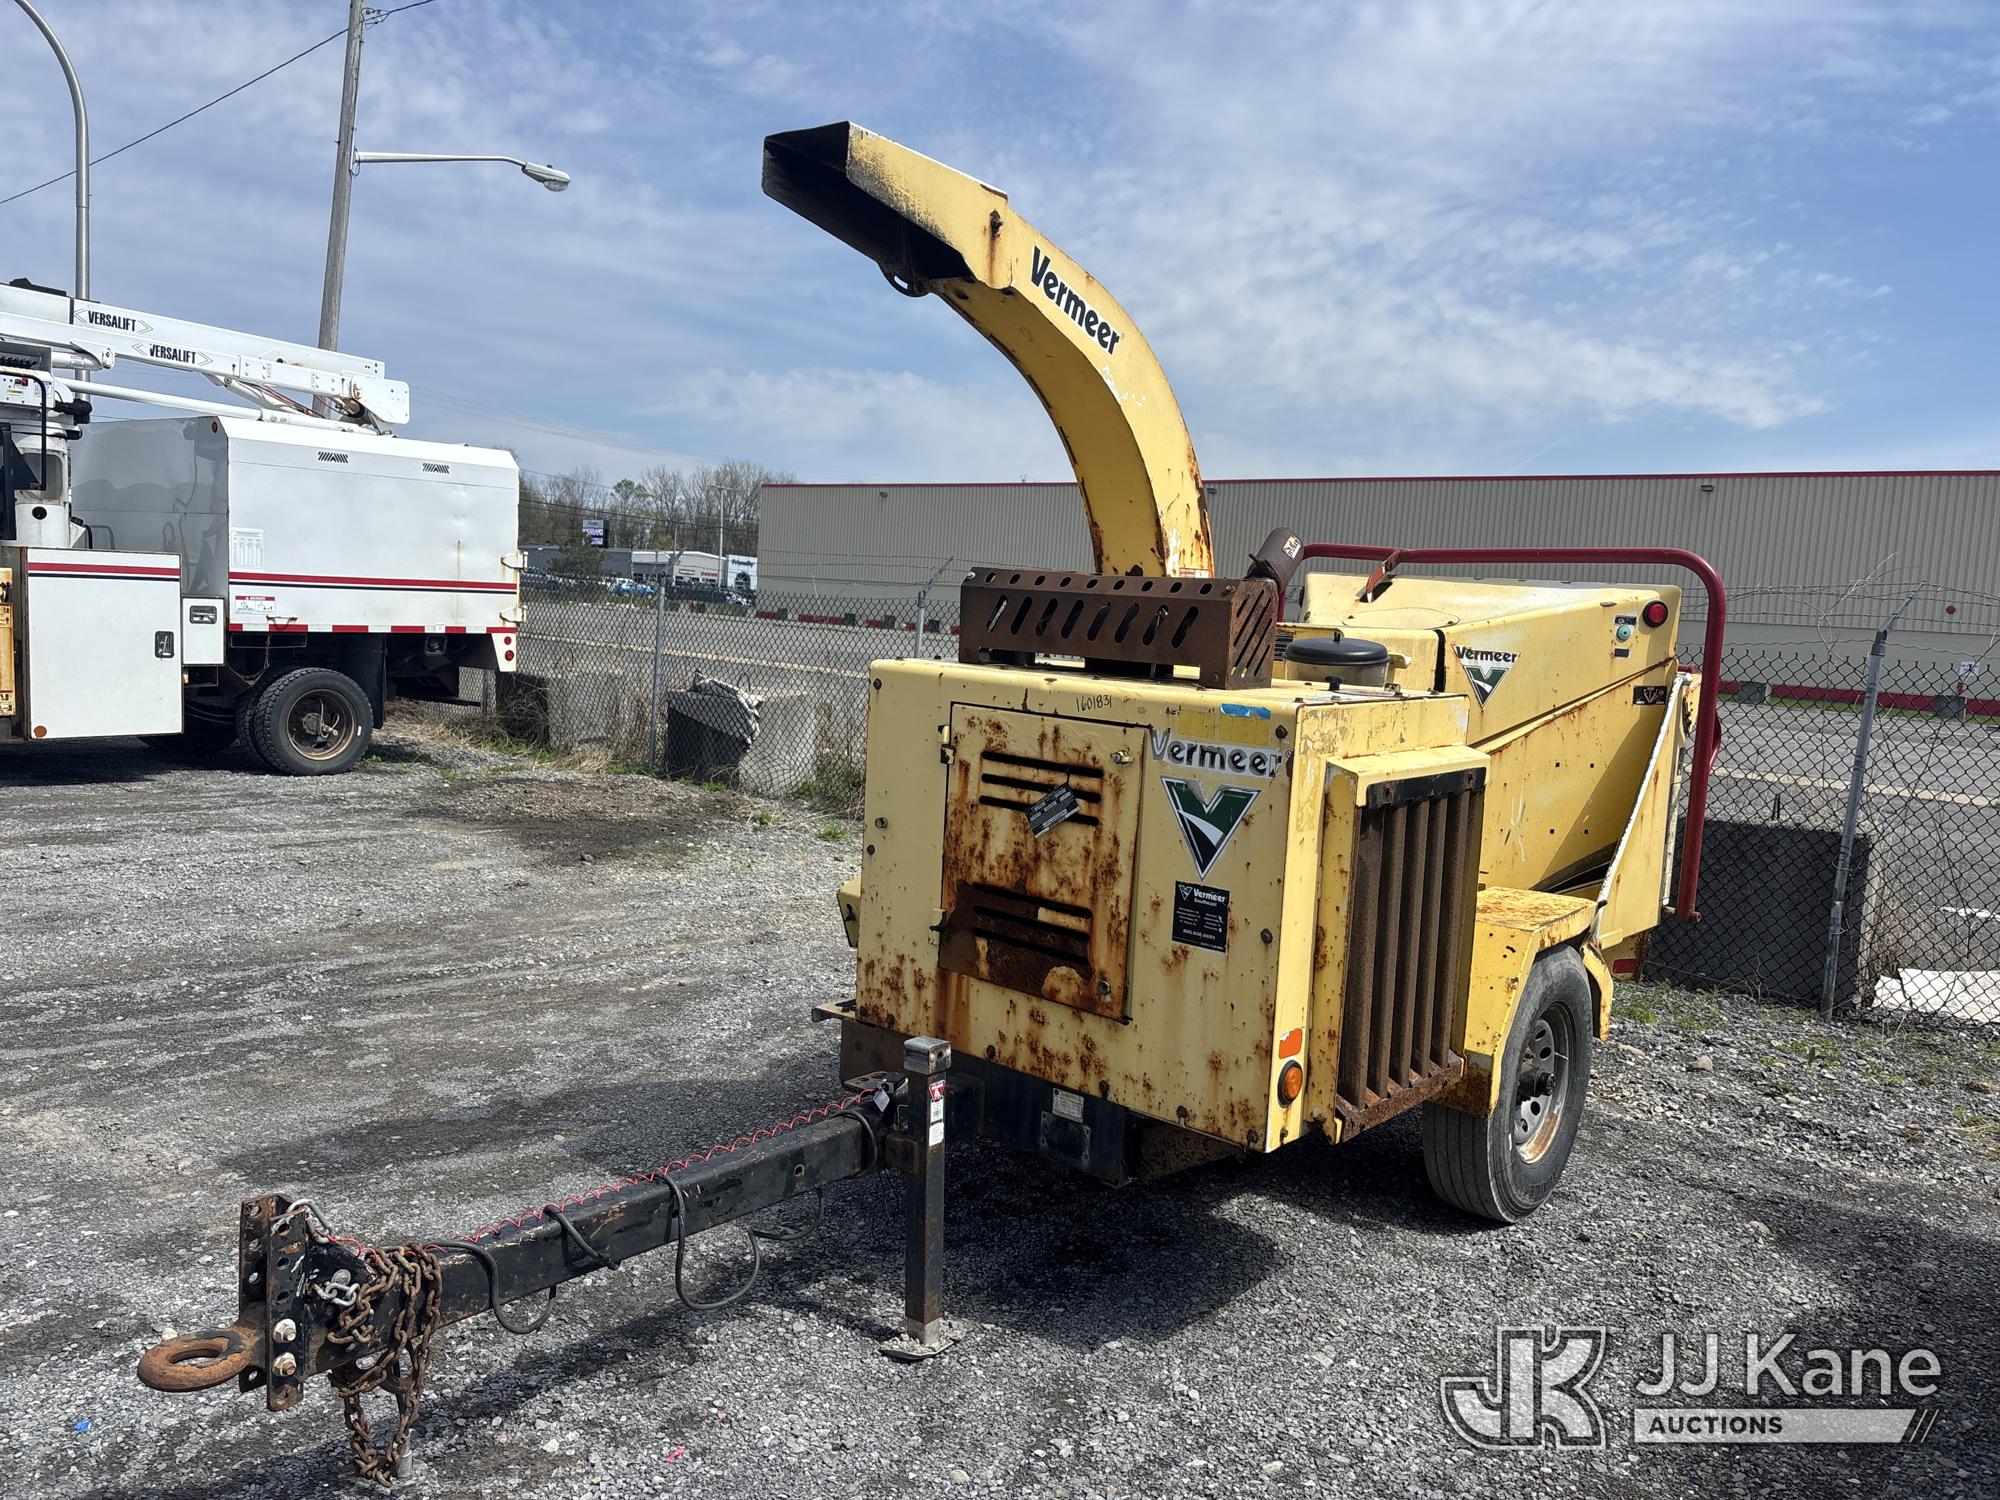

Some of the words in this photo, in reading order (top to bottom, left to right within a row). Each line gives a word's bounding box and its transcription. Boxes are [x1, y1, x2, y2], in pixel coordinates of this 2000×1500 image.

[1031, 245, 1120, 355] Vermeer
[88, 310, 136, 332] VERSALIFT
[149, 343, 196, 364] VERSALIFT
[1456, 646, 1517, 663] Vermeer
[1076, 694, 1112, 712] 1601831
[1150, 728, 1282, 777] Vermeer
[1193, 888, 1226, 903] Vermeer
